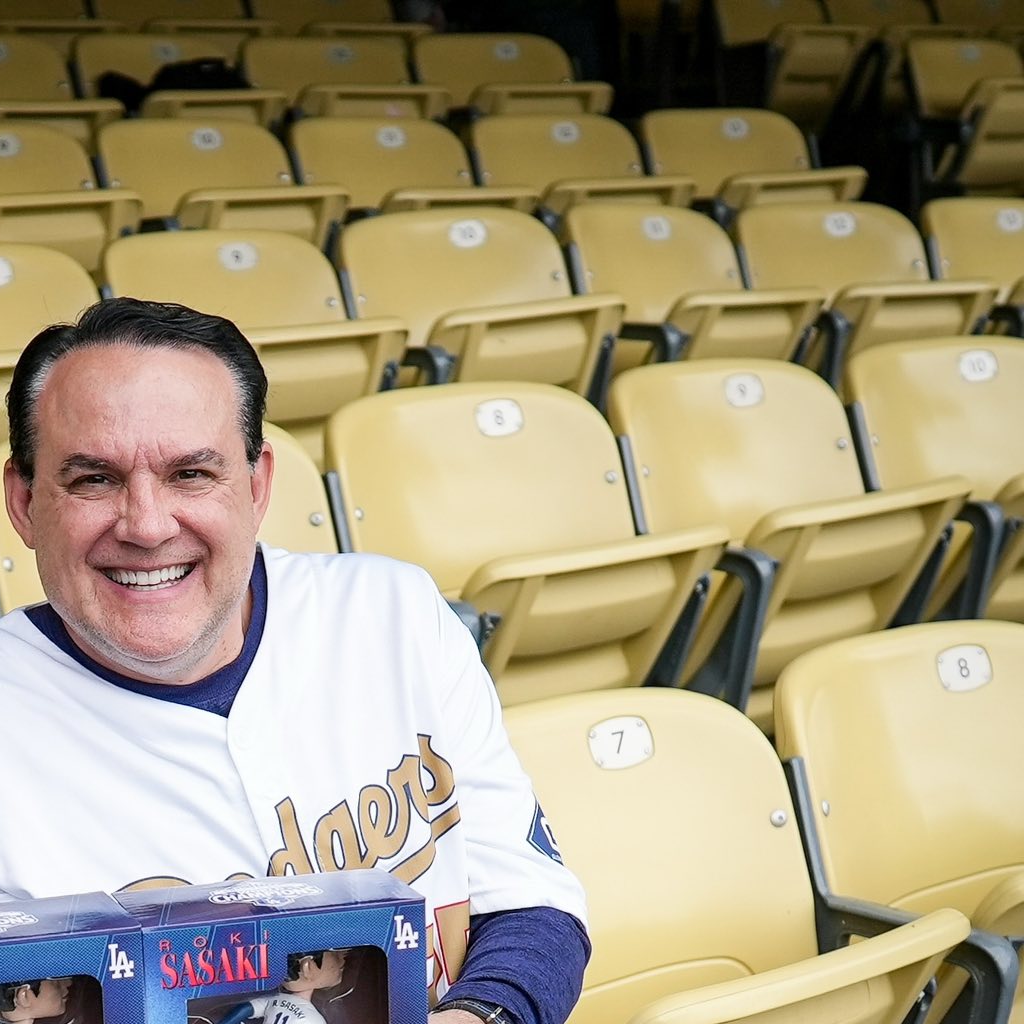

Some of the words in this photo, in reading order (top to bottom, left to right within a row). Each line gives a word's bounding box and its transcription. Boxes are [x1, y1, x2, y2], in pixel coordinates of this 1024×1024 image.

[970, 356, 987, 374] 10
[736, 383, 747, 398] 9
[493, 408, 505, 426] 8
[957, 657, 971, 679] 8
[610, 730, 624, 755] 7
[114, 733, 462, 893] dgers
[394, 914, 419, 950] LA
[108, 943, 134, 979] LA
[160, 943, 271, 990] SASAKI
[280, 1000, 306, 1020] SASAKI
